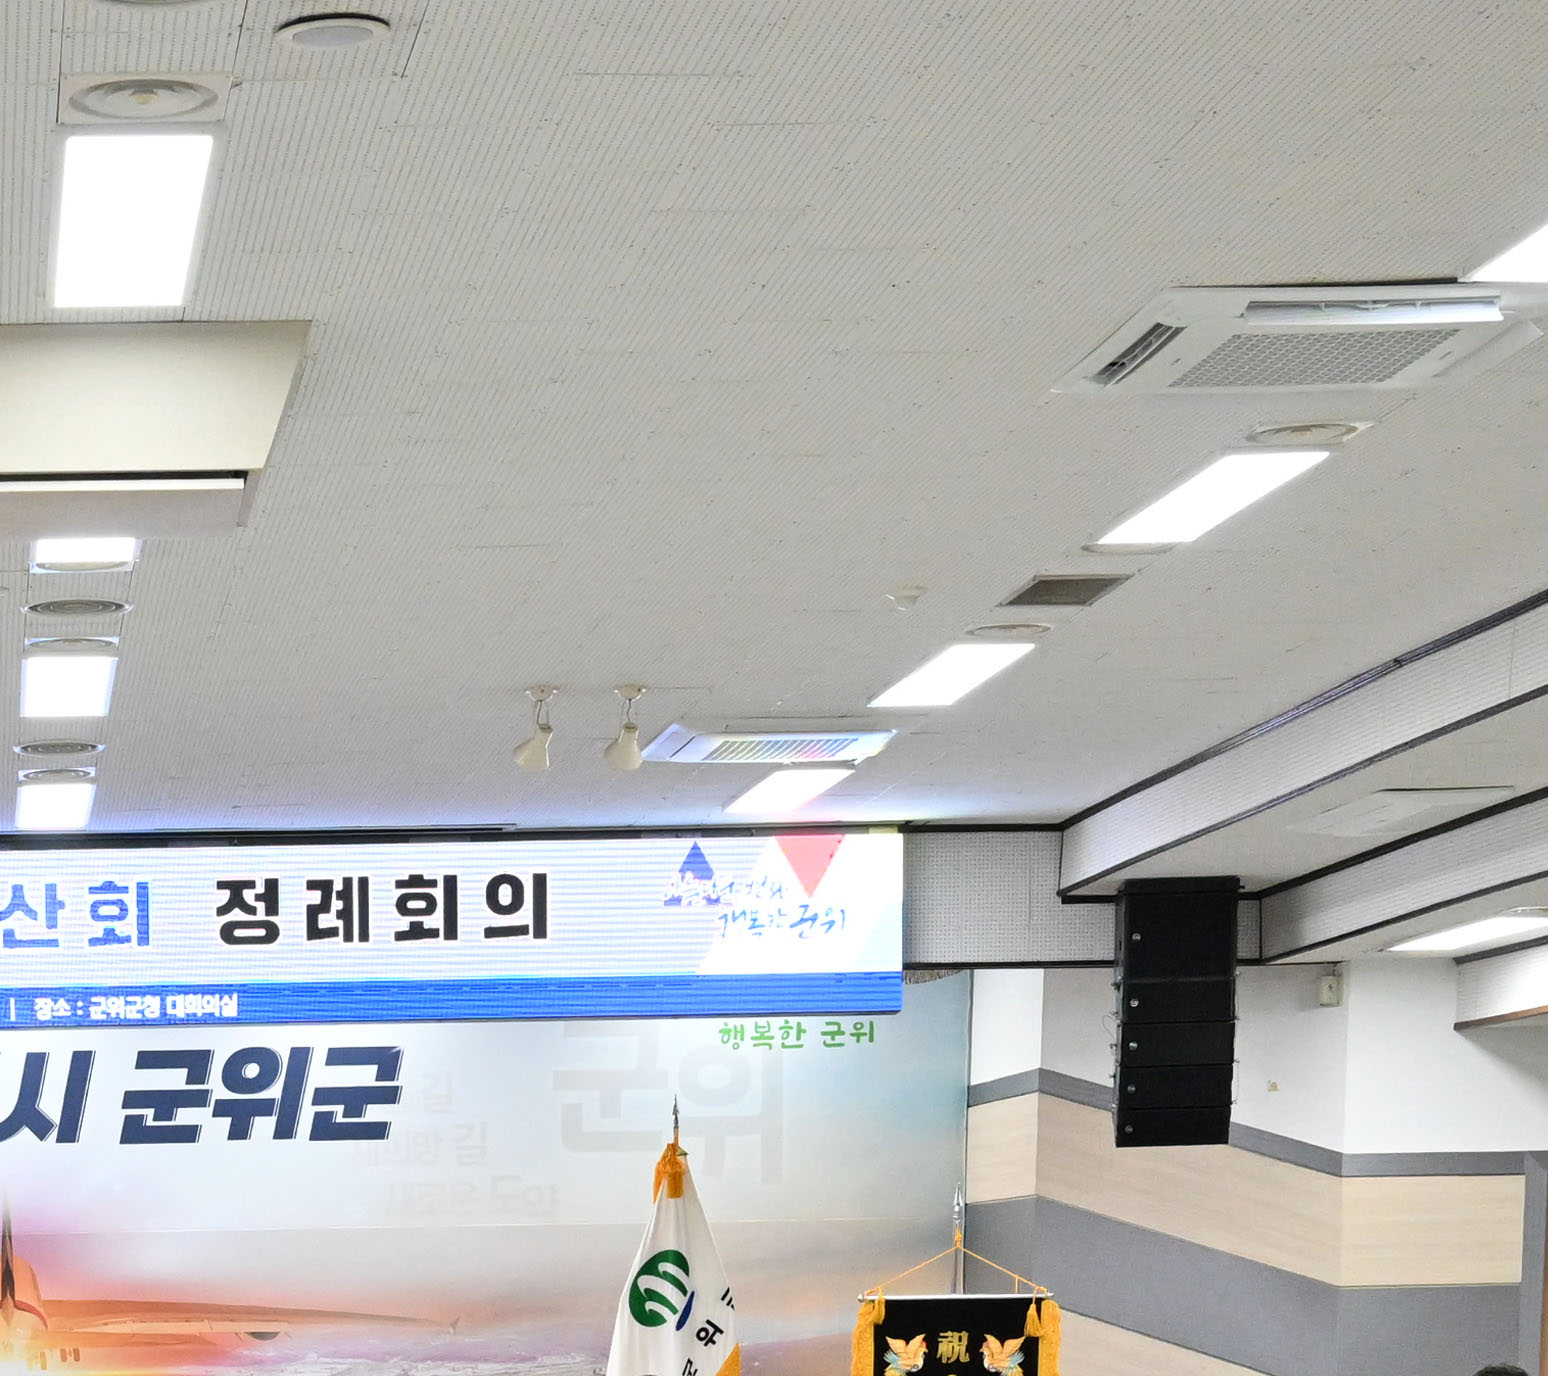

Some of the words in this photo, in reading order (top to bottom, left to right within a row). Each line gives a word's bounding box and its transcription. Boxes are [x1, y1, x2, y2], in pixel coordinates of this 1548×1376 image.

[214, 872, 550, 948] 정례회의
[34, 997, 71, 1022] 장소
[719, 1019, 807, 1050] 행복한
[820, 1020, 875, 1048] 군위
[118, 1045, 404, 1145] 군위군
[936, 1330, 971, 1364] 祝
